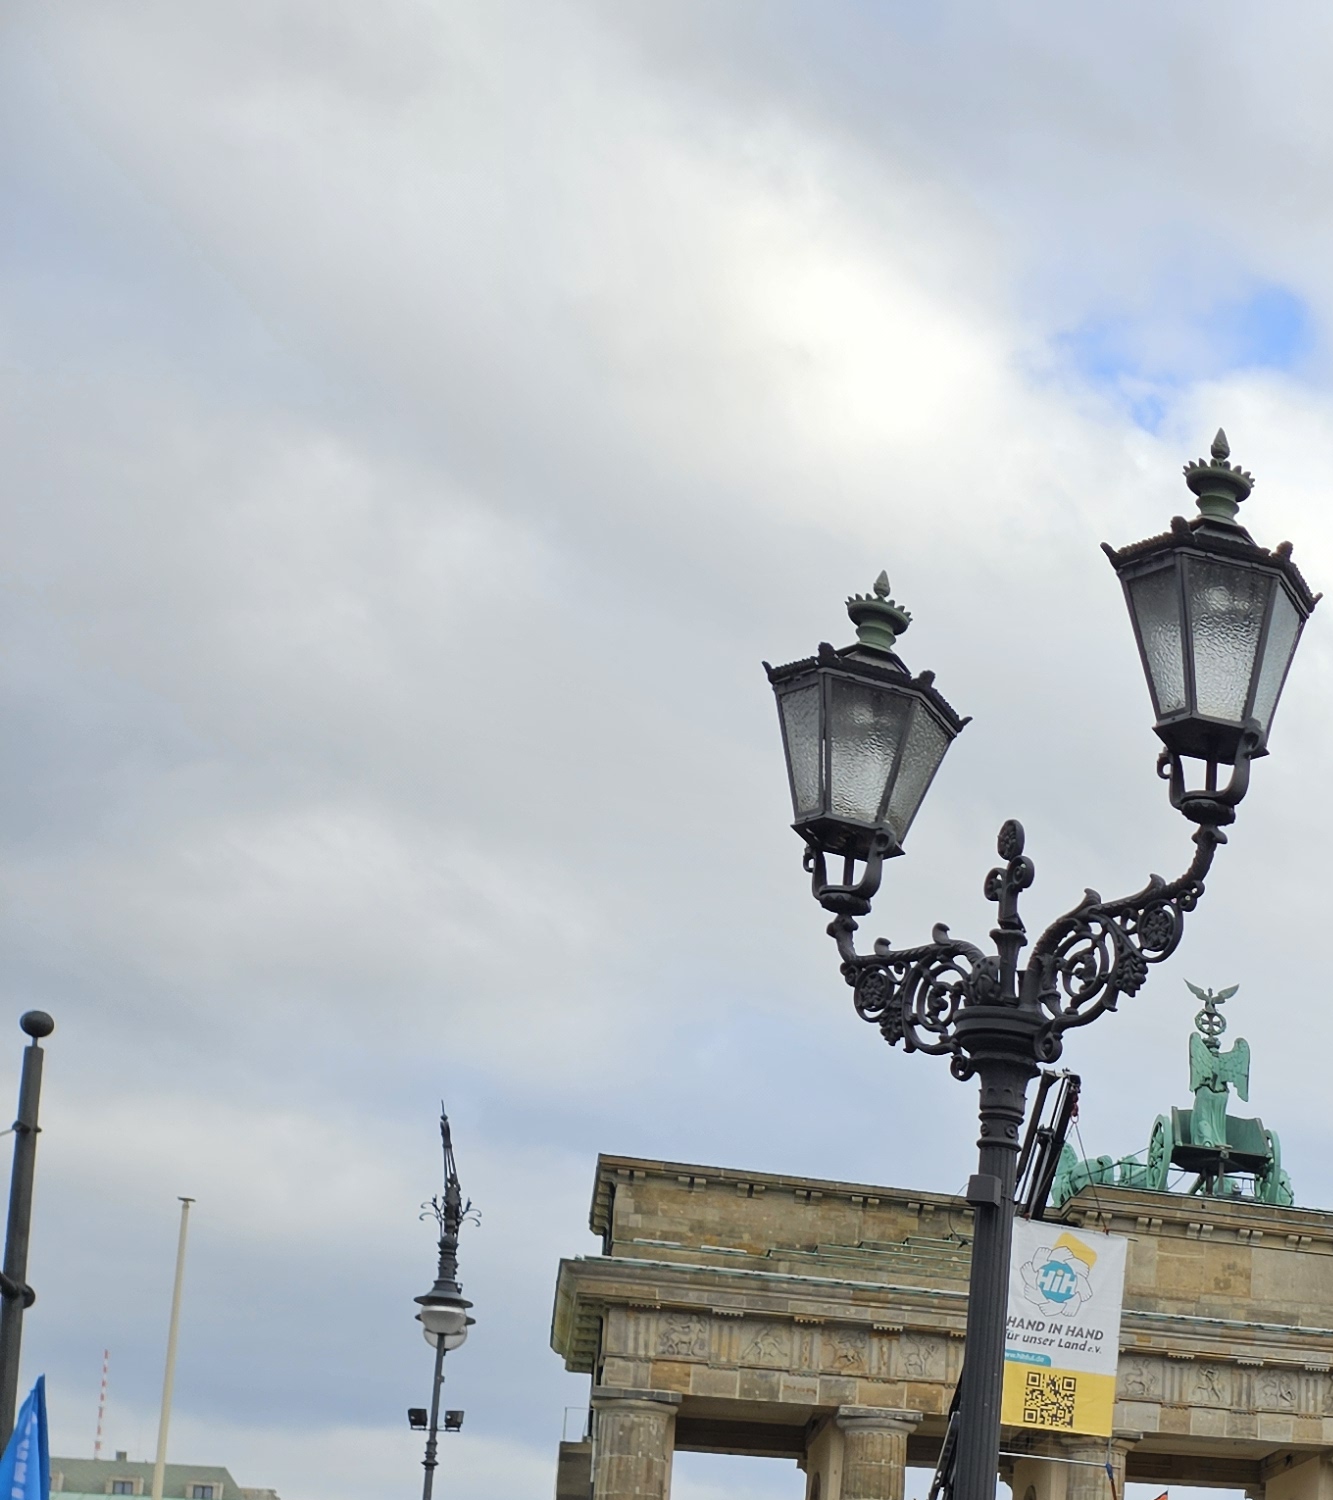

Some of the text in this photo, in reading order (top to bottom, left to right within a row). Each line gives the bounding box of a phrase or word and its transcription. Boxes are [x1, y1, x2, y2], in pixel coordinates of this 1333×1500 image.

[1038, 1269, 1077, 1295] HiH
[1006, 1315, 1104, 1341] HAND IN HAND
[1022, 1331, 1056, 1347] unser
[1058, 1338, 1088, 1352] Land
